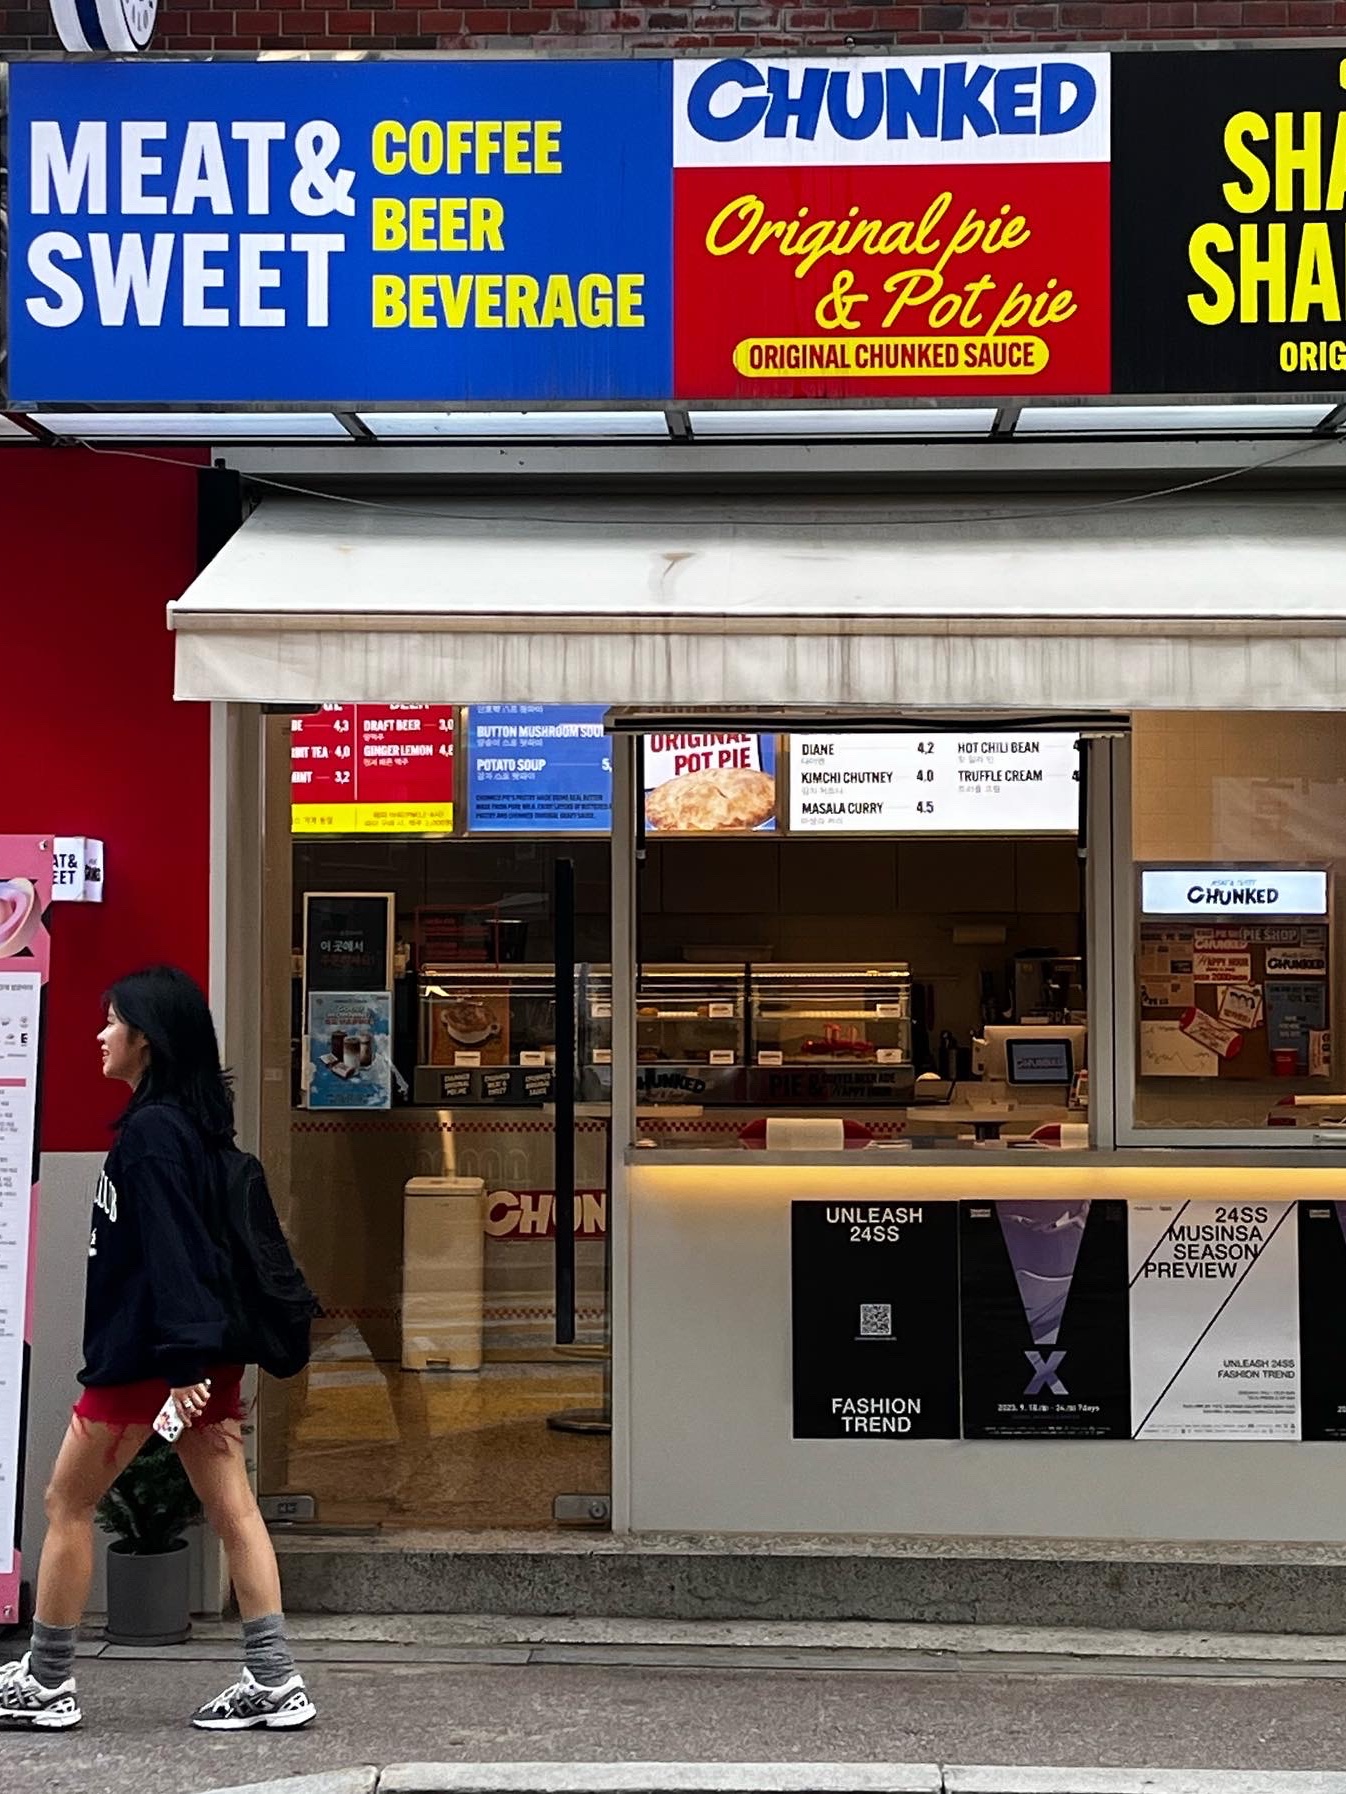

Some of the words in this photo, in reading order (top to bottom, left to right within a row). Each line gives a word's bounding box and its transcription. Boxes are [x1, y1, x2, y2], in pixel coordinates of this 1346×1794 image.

[687, 58, 1096, 142] CHUNKED
[372, 120, 562, 175] COFFEE
[372, 198, 504, 251] BEER
[705, 192, 953, 278] Original
[930, 202, 1031, 277] pie
[25, 232, 346, 327] SWEET
[1187, 222, 1346, 325] SHA
[372, 273, 645, 328] BEVERAGE
[814, 269, 869, 330] &
[881, 268, 998, 330] Pot
[984, 277, 1077, 337] pie
[749, 343, 852, 369] ORIGINAL
[855, 341, 958, 368] CHUNKED
[964, 341, 1034, 367] SAUCE
[364, 720, 394, 731] DRAFT
[396, 719, 421, 730] BEER
[477, 725, 516, 737] BUTTON
[518, 724, 577, 738] MUSHROOM
[311, 746, 328, 758] TEA
[364, 745, 399, 756] GINGER
[401, 745, 433, 756] LEMON
[802, 744, 834, 755] DIANE
[958, 742, 978, 753] HOT
[1011, 742, 1040, 753] BEAN
[477, 759, 517, 771] POTATO
[517, 759, 546, 771] SOUP
[675, 752, 713, 775] POT
[719, 747, 751, 768] PIE
[801, 772, 841, 783] KIMCHI
[843, 771, 893, 783] CHUTNEY
[958, 770, 1002, 781] TRUFFLE
[1005, 770, 1042, 781] CREAM
[802, 803, 845, 814] MASALA
[848, 803, 883, 814] CURRY
[1187, 886, 1279, 906] CHUNKED
[826, 1207, 923, 1223] UNLEASH
[1215, 1207, 1268, 1223] 24SS
[850, 1226, 899, 1242] 24SS
[1168, 1225, 1263, 1241] MUSINSA
[1173, 1243, 1258, 1260] SEASON
[1144, 1262, 1237, 1278] PREVIEW
[1223, 1359, 1269, 1369] UNLEASH
[1023, 1350, 1069, 1395] X
[1217, 1370, 1259, 1379] FASHION
[1262, 1370, 1295, 1379] TREND
[832, 1398, 921, 1414] FASHION
[841, 1416, 912, 1432] TREND
